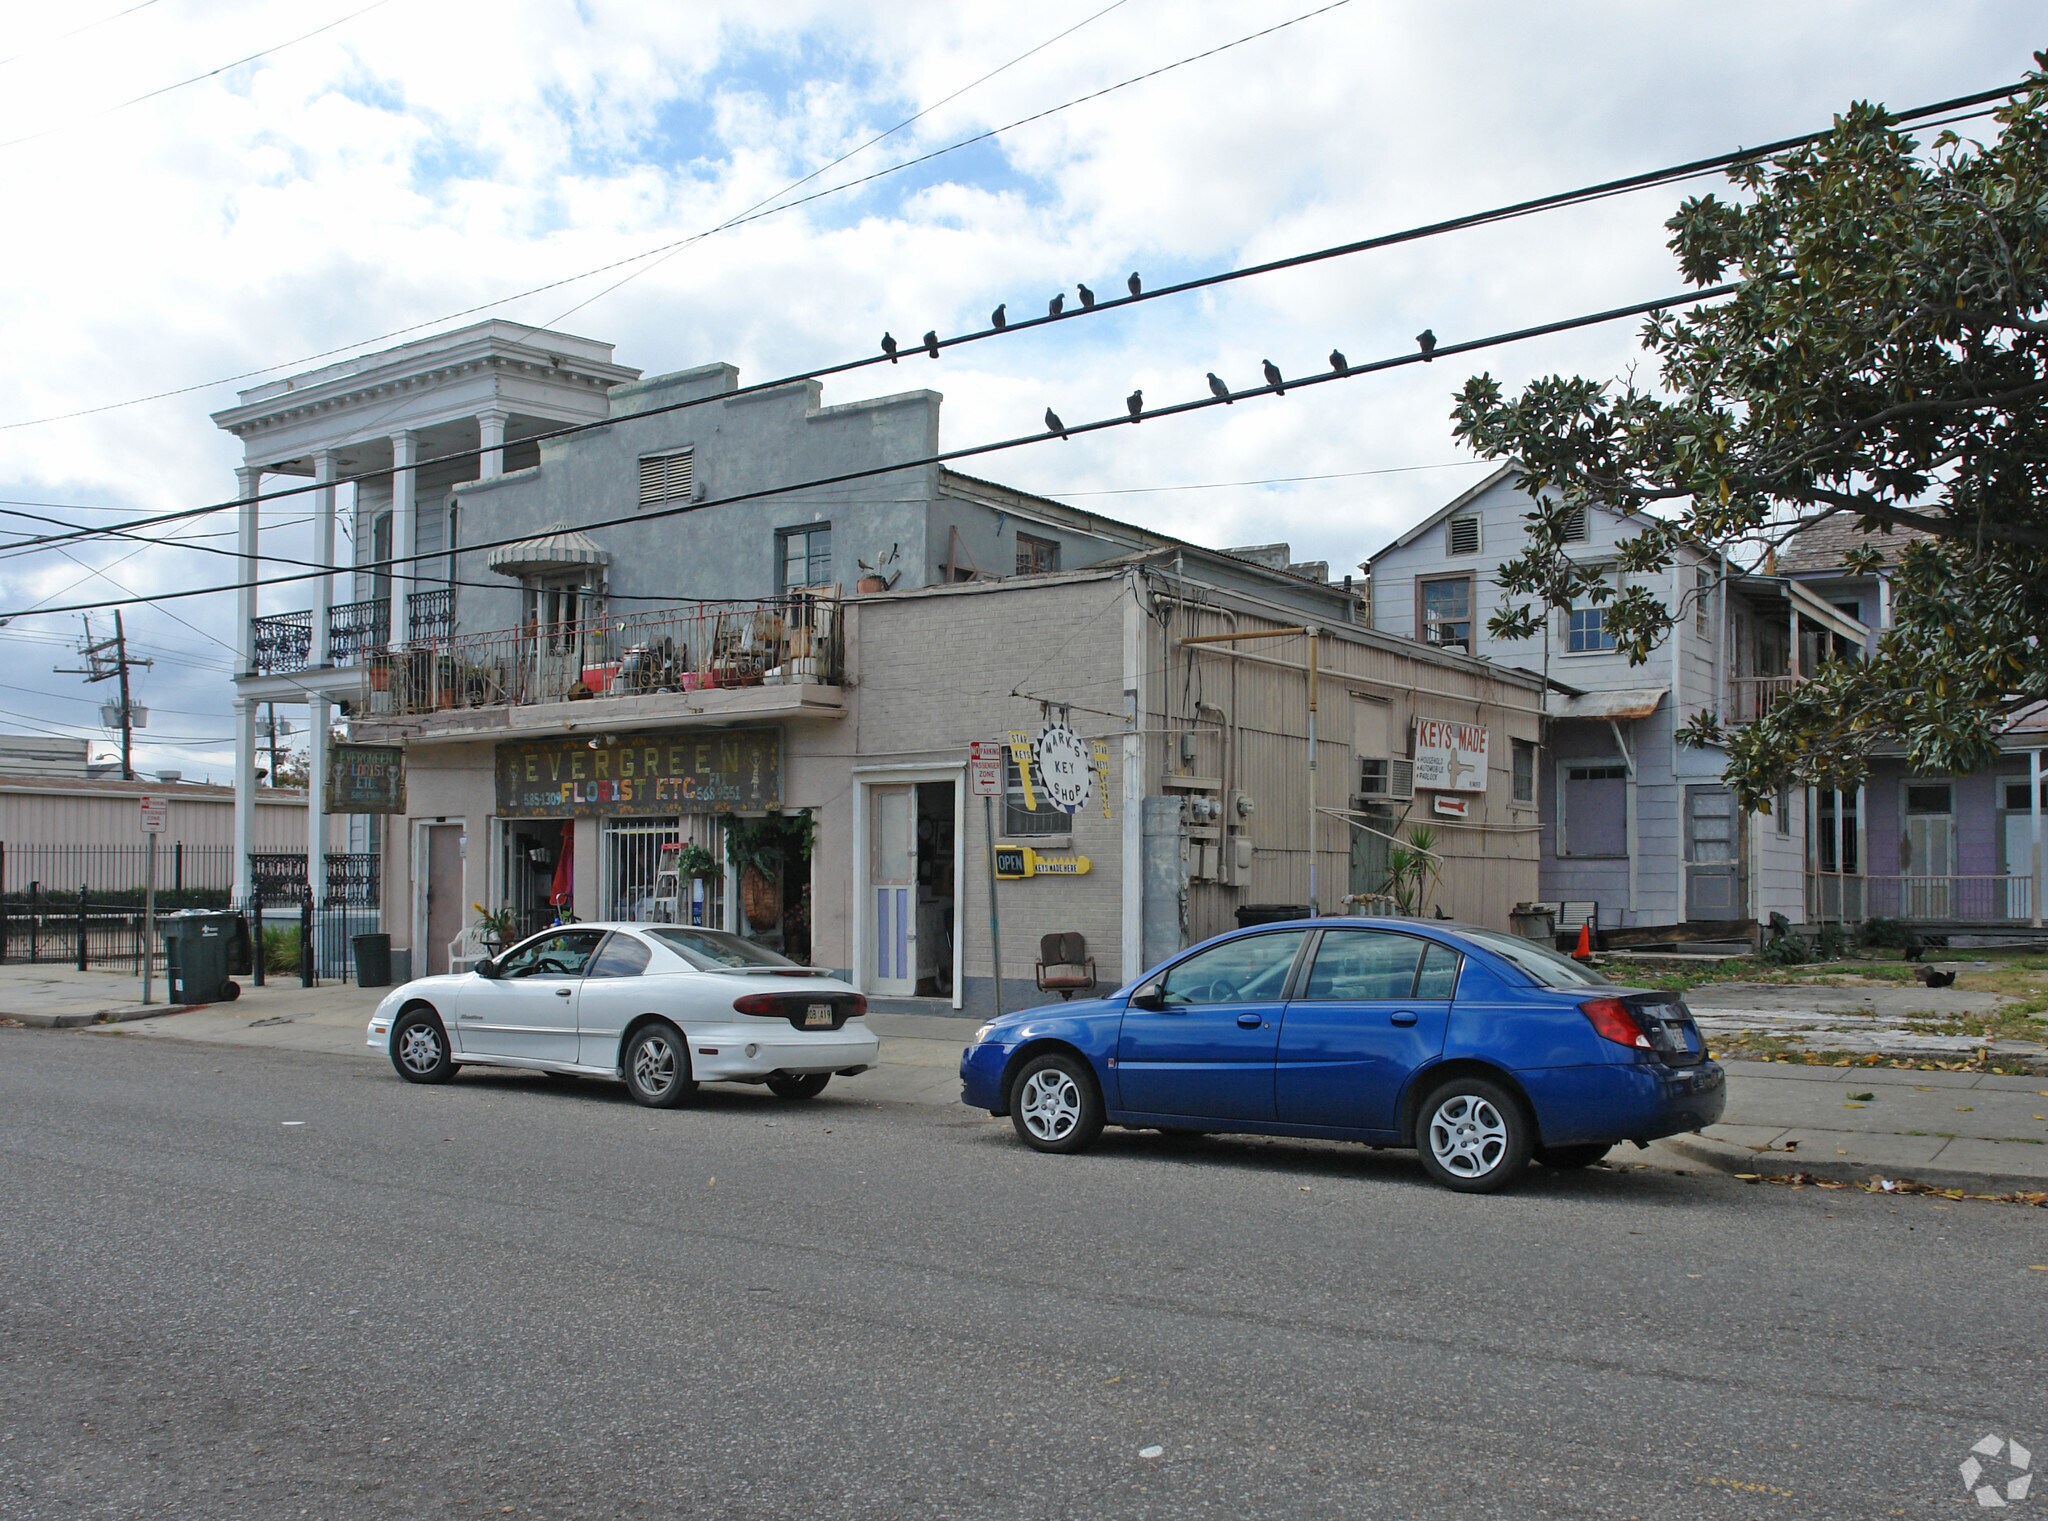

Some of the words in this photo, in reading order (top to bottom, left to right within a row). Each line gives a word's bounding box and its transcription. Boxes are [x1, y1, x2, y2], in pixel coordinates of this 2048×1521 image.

[1011, 734, 1027, 744] STAR
[1420, 721, 1452, 749] KEYS
[1459, 726, 1486, 753] MADE
[1015, 750, 1031, 759] KEYS
[525, 743, 739, 782] EVERGREEN
[972, 761, 1000, 769] PASSENGER
[1054, 761, 1074, 774] KEY
[1096, 760, 1108, 770] KEYS
[561, 779, 647, 803] FLORIST
[656, 777, 696, 800] ETC
[1054, 783, 1080, 802] SHOP
[524, 791, 561, 806] 585-1309
[998, 855, 1023, 871] OPEN
[1035, 864, 1048, 872] KEYS
[1050, 864, 1063, 872] MADE
[1064, 864, 1077, 872] HERE
